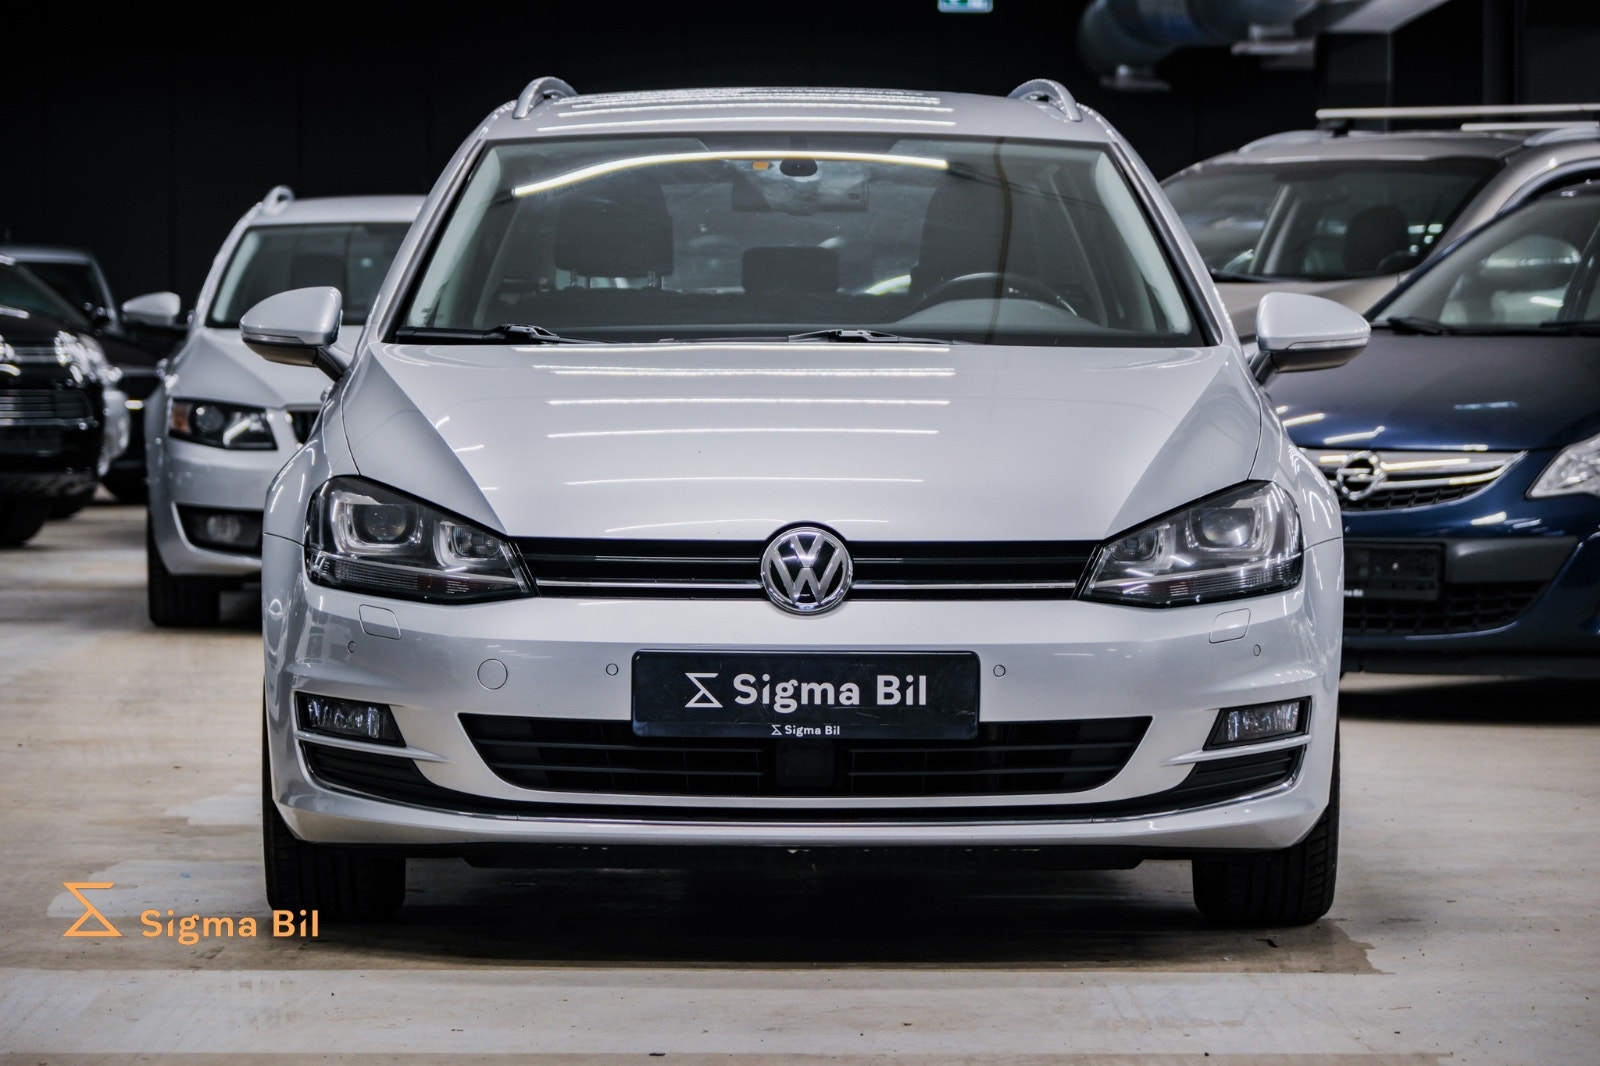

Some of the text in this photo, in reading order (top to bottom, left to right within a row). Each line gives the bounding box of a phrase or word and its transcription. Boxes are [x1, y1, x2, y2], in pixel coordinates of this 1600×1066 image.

[733, 673, 927, 714] Sigma Bil
[784, 724, 841, 738] Sigma Bil
